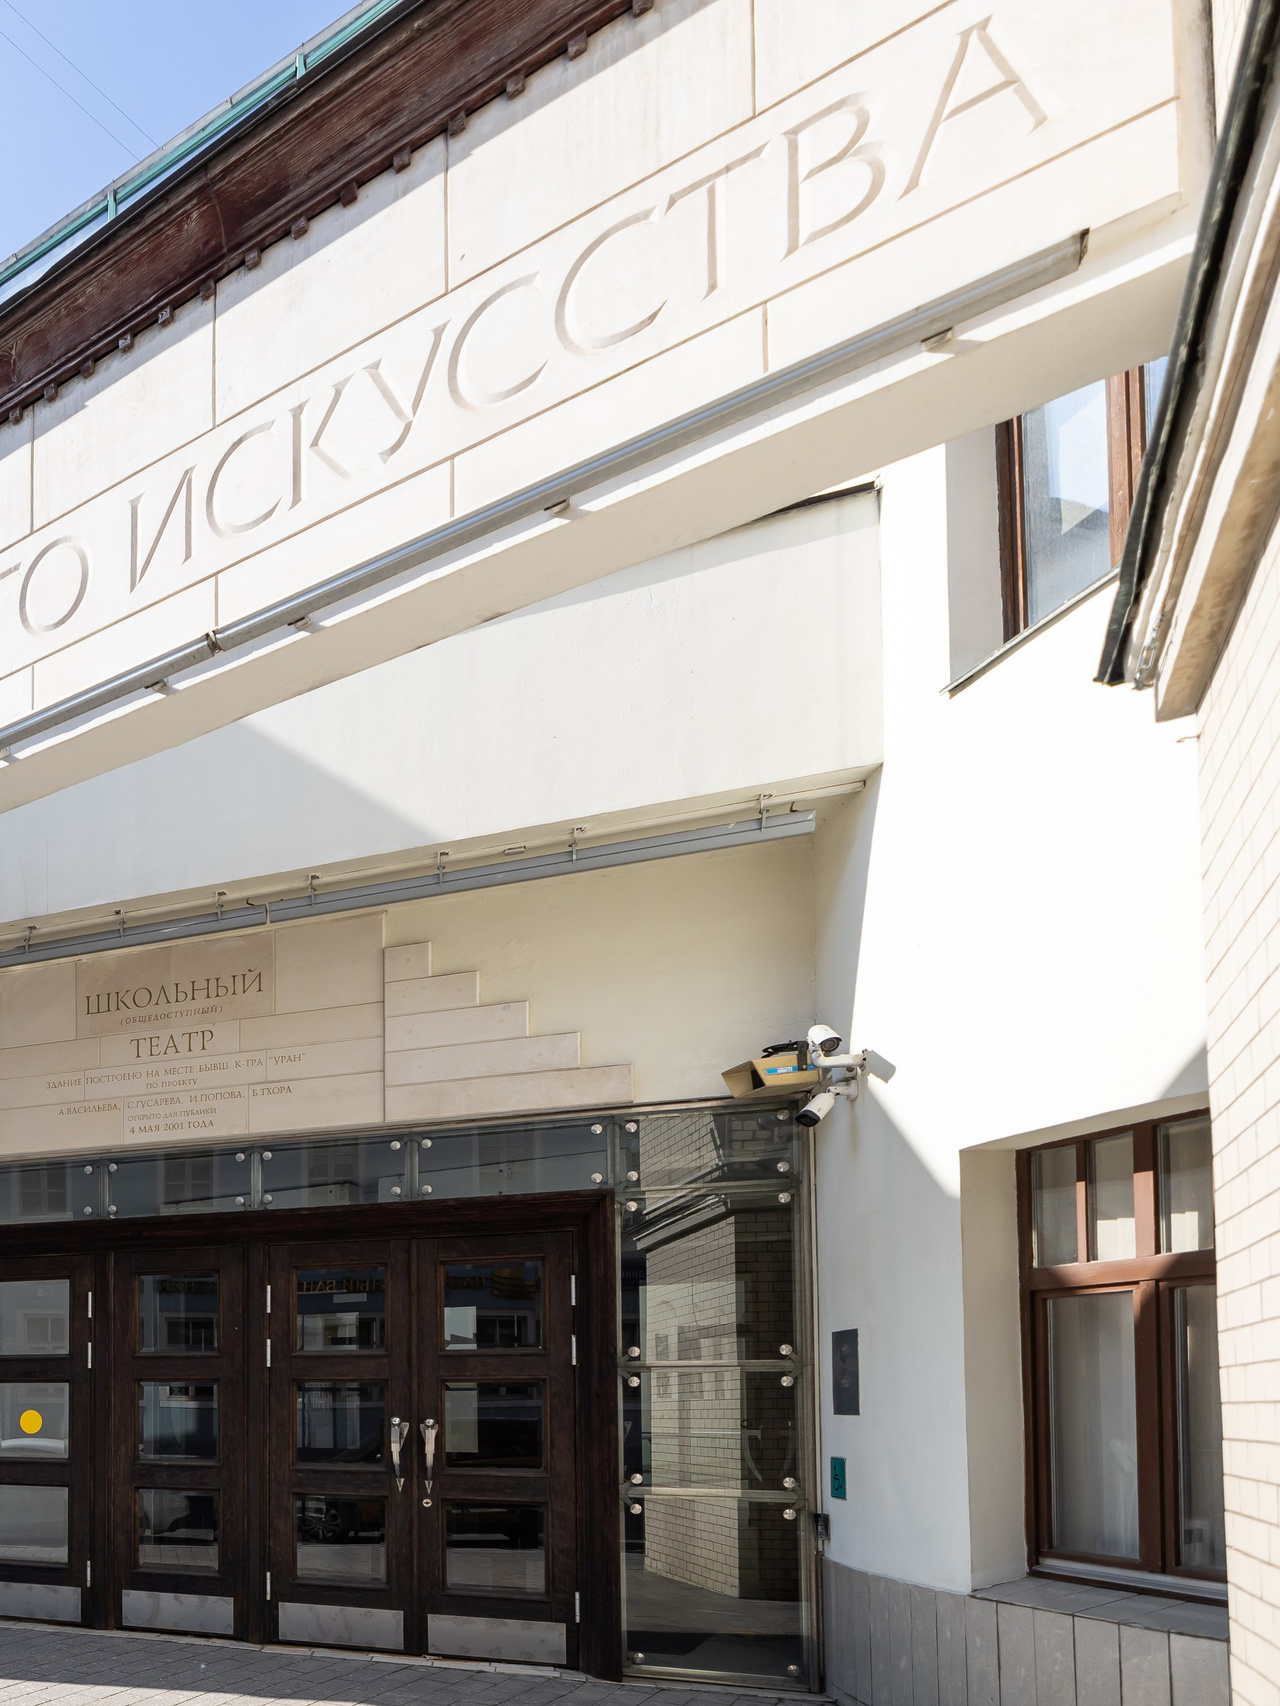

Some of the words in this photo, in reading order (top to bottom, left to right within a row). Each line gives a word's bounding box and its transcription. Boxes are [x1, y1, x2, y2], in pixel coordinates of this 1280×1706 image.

[129, 14, 1049, 595] ИСКУССТВА
[85, 967, 265, 1016] ШКОЛЬНЫЙ
[120, 1005, 223, 1026] (ОБЩЕДОСТУПНЫЙ)
[129, 1029, 214, 1059] ТЕАТР
[46, 1078, 82, 1089] ЗДАНИЕ
[86, 1071, 142, 1085] ПОСТРОЕНО
[146, 1069, 160, 1078] НА
[164, 1065, 195, 1076] МЕСТЕ
[235, 1058, 263, 1069] К-ТРА
[146, 1082, 158, 1090] ПО
[161, 1078, 198, 1088] ПРОЕКТУ
[127, 1112, 161, 1122] ОТКРЫТО
[163, 1110, 178, 1119] ДЛЯ
[180, 1106, 217, 1117] ПУБЛИКИ
[130, 1126, 135, 1134] 4
[138, 1124, 160, 1133] МАЯ
[163, 1121, 184, 1131] 2001
[188, 1119, 214, 1129] ГОДА
